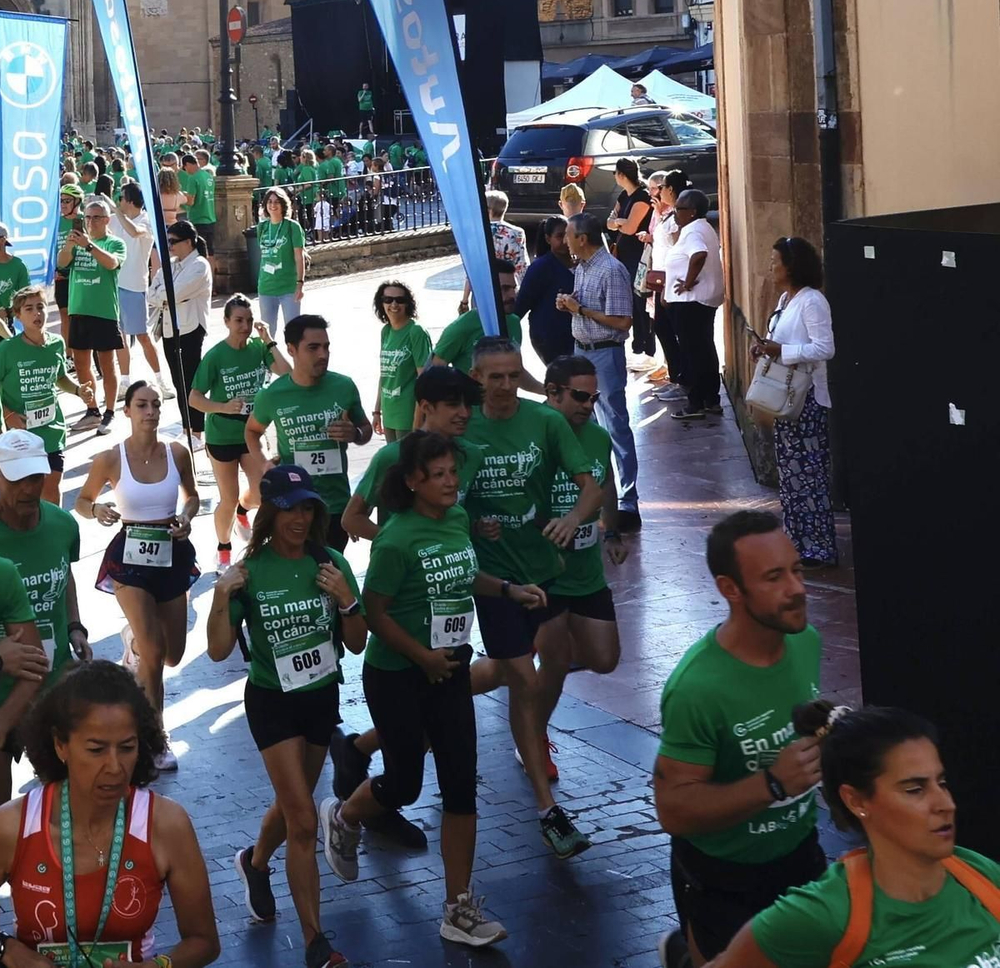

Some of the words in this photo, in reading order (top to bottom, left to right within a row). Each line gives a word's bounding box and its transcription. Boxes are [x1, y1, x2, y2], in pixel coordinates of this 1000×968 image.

[12, 130, 49, 276] utosa
[19, 368, 31, 377] En
[20, 375, 45, 384] contra
[222, 375, 235, 384] En
[224, 380, 251, 392] contra
[20, 384, 28, 392] el
[226, 391, 234, 399] el
[34, 408, 49, 420] 1012
[280, 416, 294, 427] En
[297, 409, 337, 424] marcha
[284, 423, 316, 436] contra
[310, 452, 326, 465] 25
[484, 452, 533, 466] marcha
[476, 466, 507, 479] ontra
[482, 478, 527, 490] cáncer
[551, 482, 580, 493] ontra
[557, 492, 578, 504] cán
[138, 541, 160, 556] 347
[421, 557, 442, 570] En
[425, 565, 465, 583] contra
[427, 583, 441, 595] el
[34, 600, 56, 613] cer
[260, 603, 280, 618] En
[263, 614, 310, 631] contra
[444, 616, 466, 634] 609
[267, 630, 281, 644] el
[292, 649, 322, 672] 608
[740, 738, 769, 755] En
